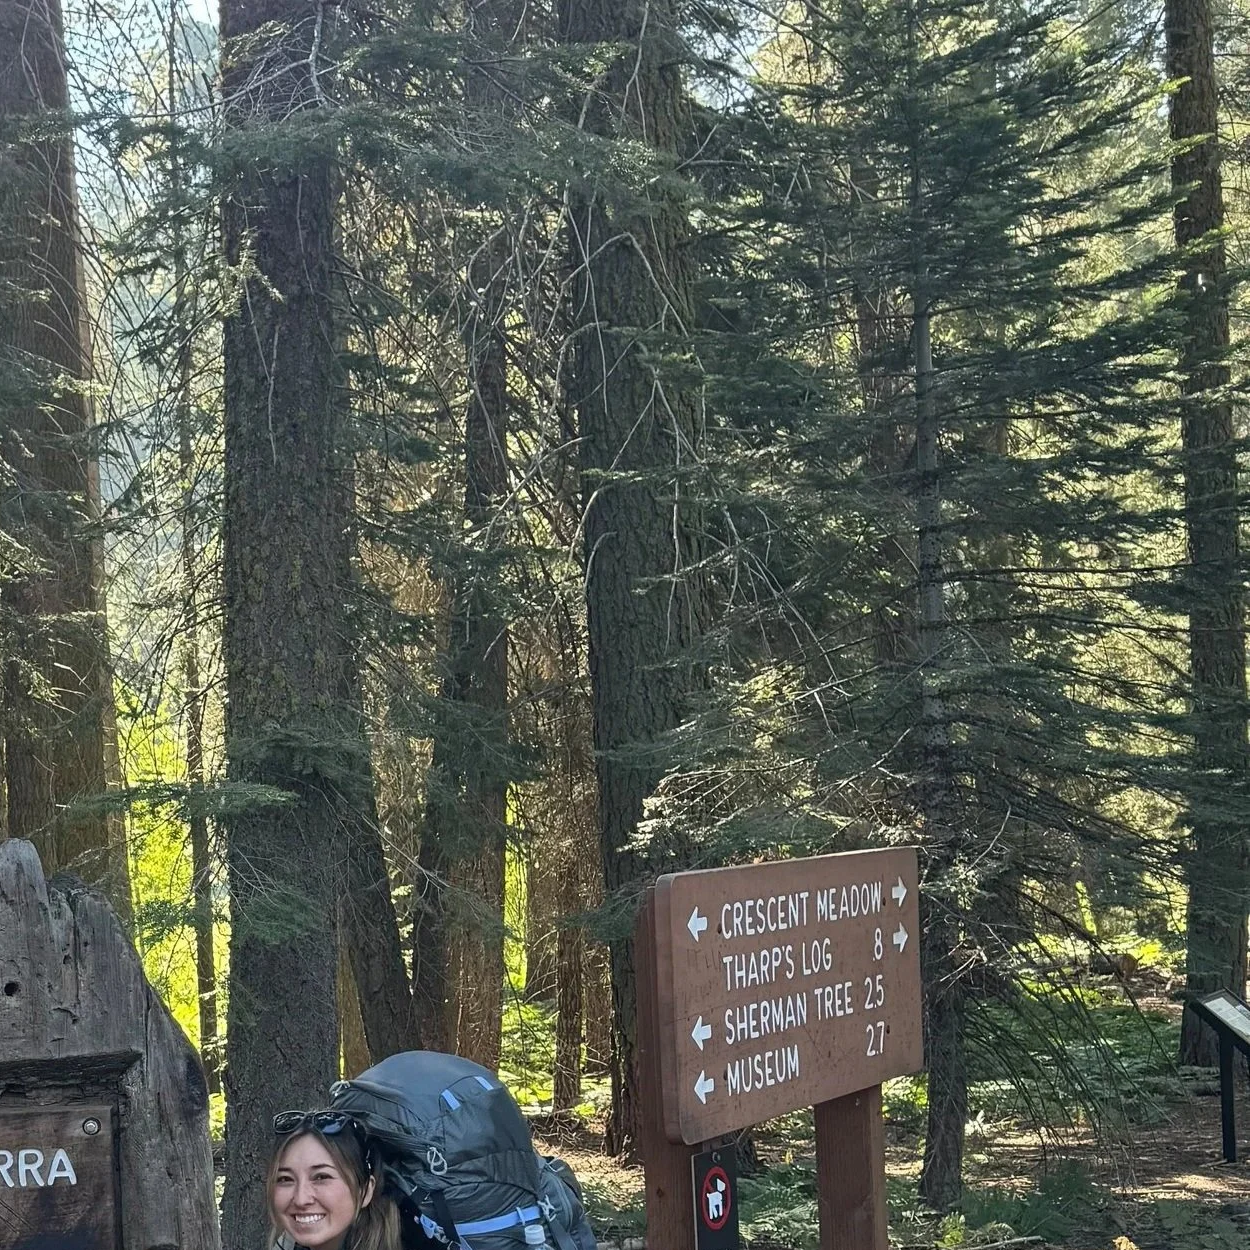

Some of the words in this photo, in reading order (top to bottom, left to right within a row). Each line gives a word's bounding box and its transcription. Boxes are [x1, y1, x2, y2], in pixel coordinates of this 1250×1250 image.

[721, 891, 810, 940] CRESCENT
[816, 881, 882, 922] MEADOW
[722, 945, 794, 991] THARP'S
[802, 938, 832, 976] LOG
[872, 928, 883, 962] .8
[725, 992, 807, 1045] SHERMAN
[814, 982, 854, 1020] TREE
[864, 974, 884, 1010] 2.5
[726, 1044, 800, 1096] MUSEUM
[866, 1022, 885, 1057] 2.7
